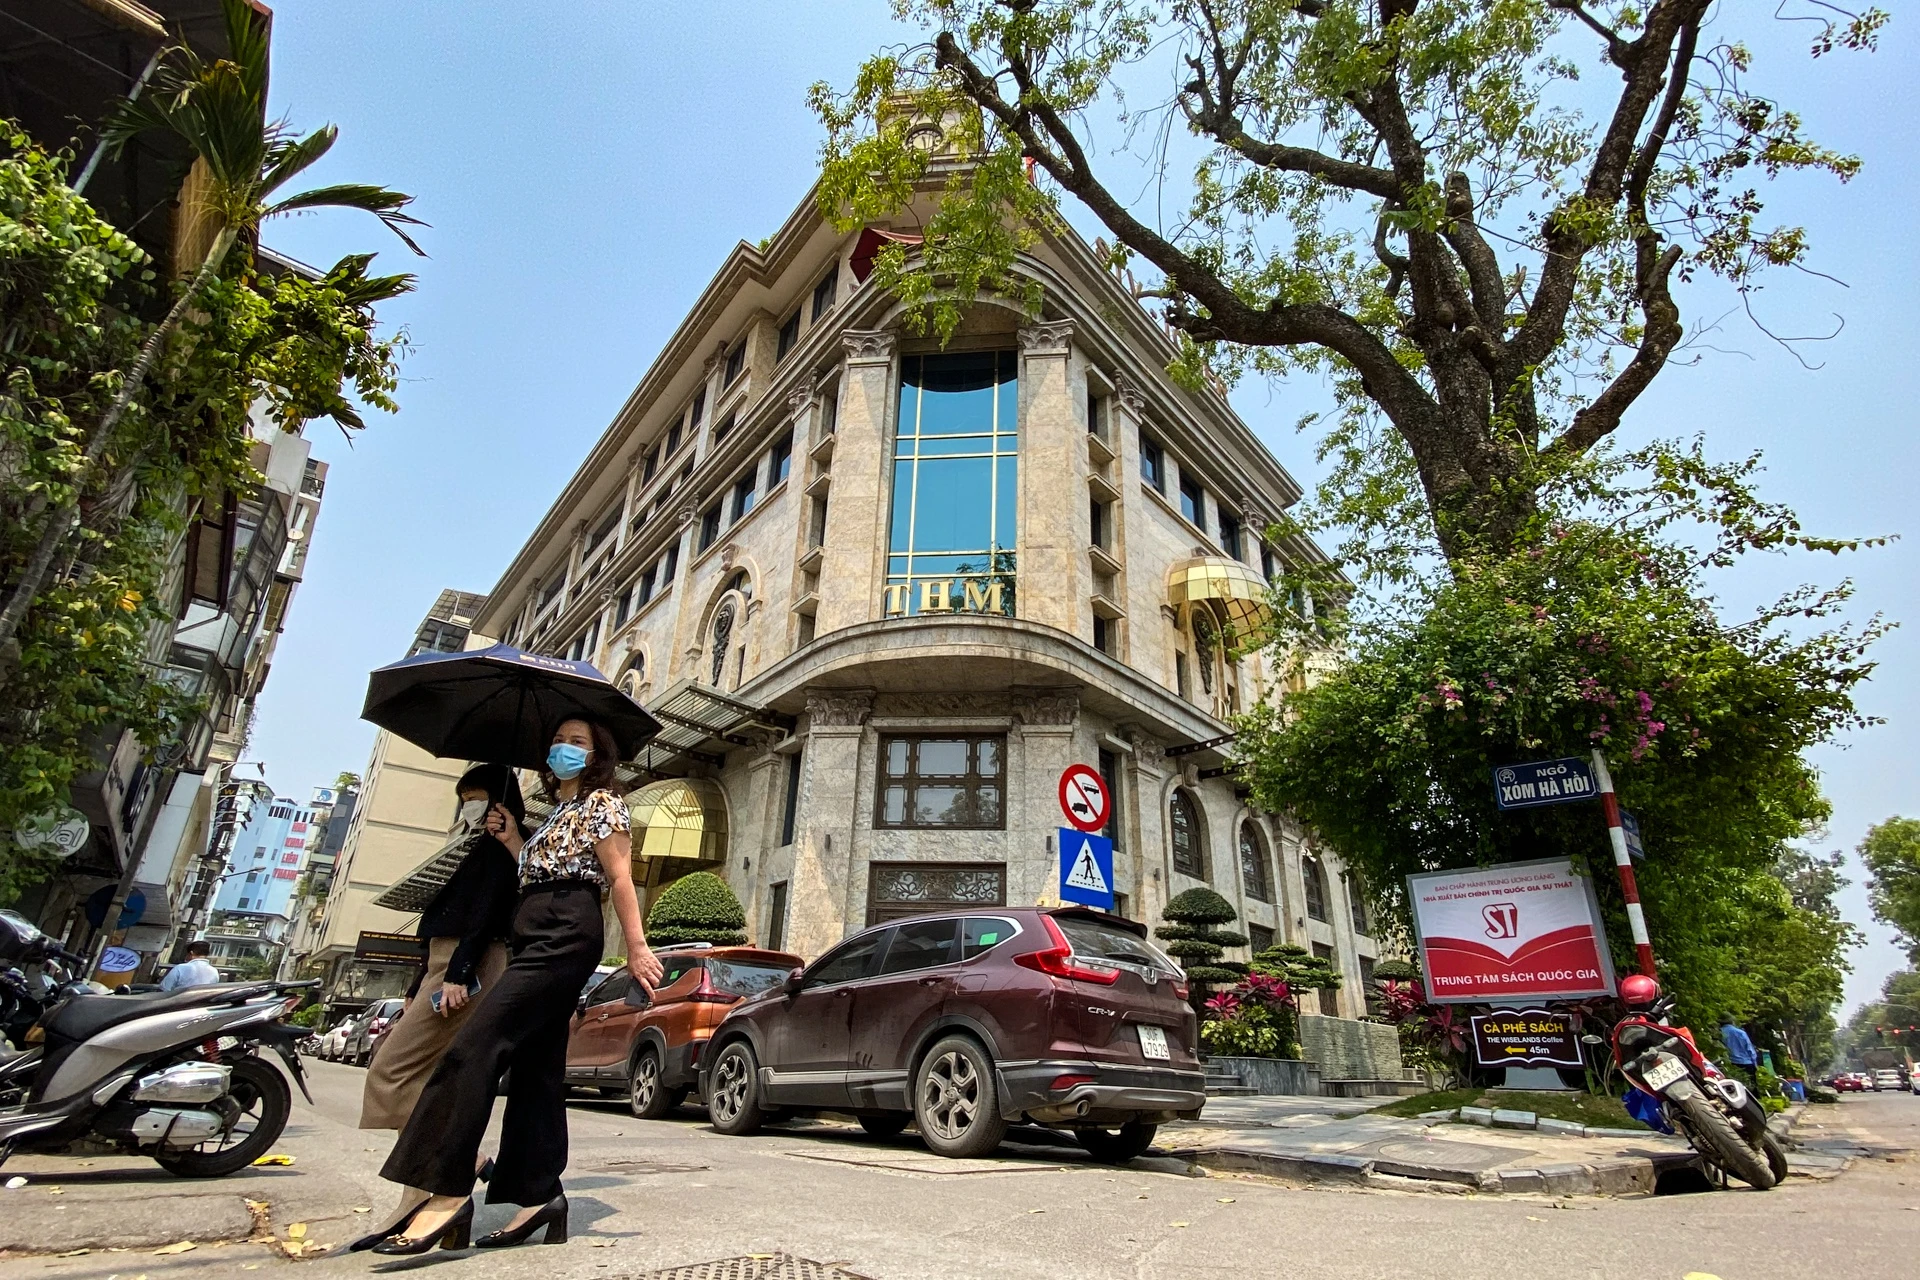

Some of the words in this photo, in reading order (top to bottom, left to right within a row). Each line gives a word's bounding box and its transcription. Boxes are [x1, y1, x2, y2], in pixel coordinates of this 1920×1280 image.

[884, 579, 1005, 616] THM
[1536, 764, 1567, 777] NGÕ
[1502, 781, 1536, 802] XÓM
[1538, 777, 1560, 797] HÀ
[1562, 771, 1590, 794] HỒI
[1467, 880, 1486, 889] HÀNH
[1487, 876, 1509, 886] TRUNG
[1468, 890, 1490, 898] CHÍNH
[1504, 885, 1525, 894] QUỐC
[1527, 884, 1541, 892] GIA
[1543, 882, 1553, 891] SỰ
[1482, 902, 1518, 939] ST
[1434, 975, 1473, 986] TRUNG
[1501, 971, 1535, 983] SÁCH
[1537, 969, 1573, 981] QUỐC
[1576, 969, 1599, 979] GIA
[1088, 1006, 1116, 1017] CR-V
[1483, 1021, 1500, 1033] CÀ
[1502, 1021, 1527, 1033] PHÊ
[1529, 1020, 1564, 1033] SÁCH
[1529, 1045, 1550, 1054] 45m
